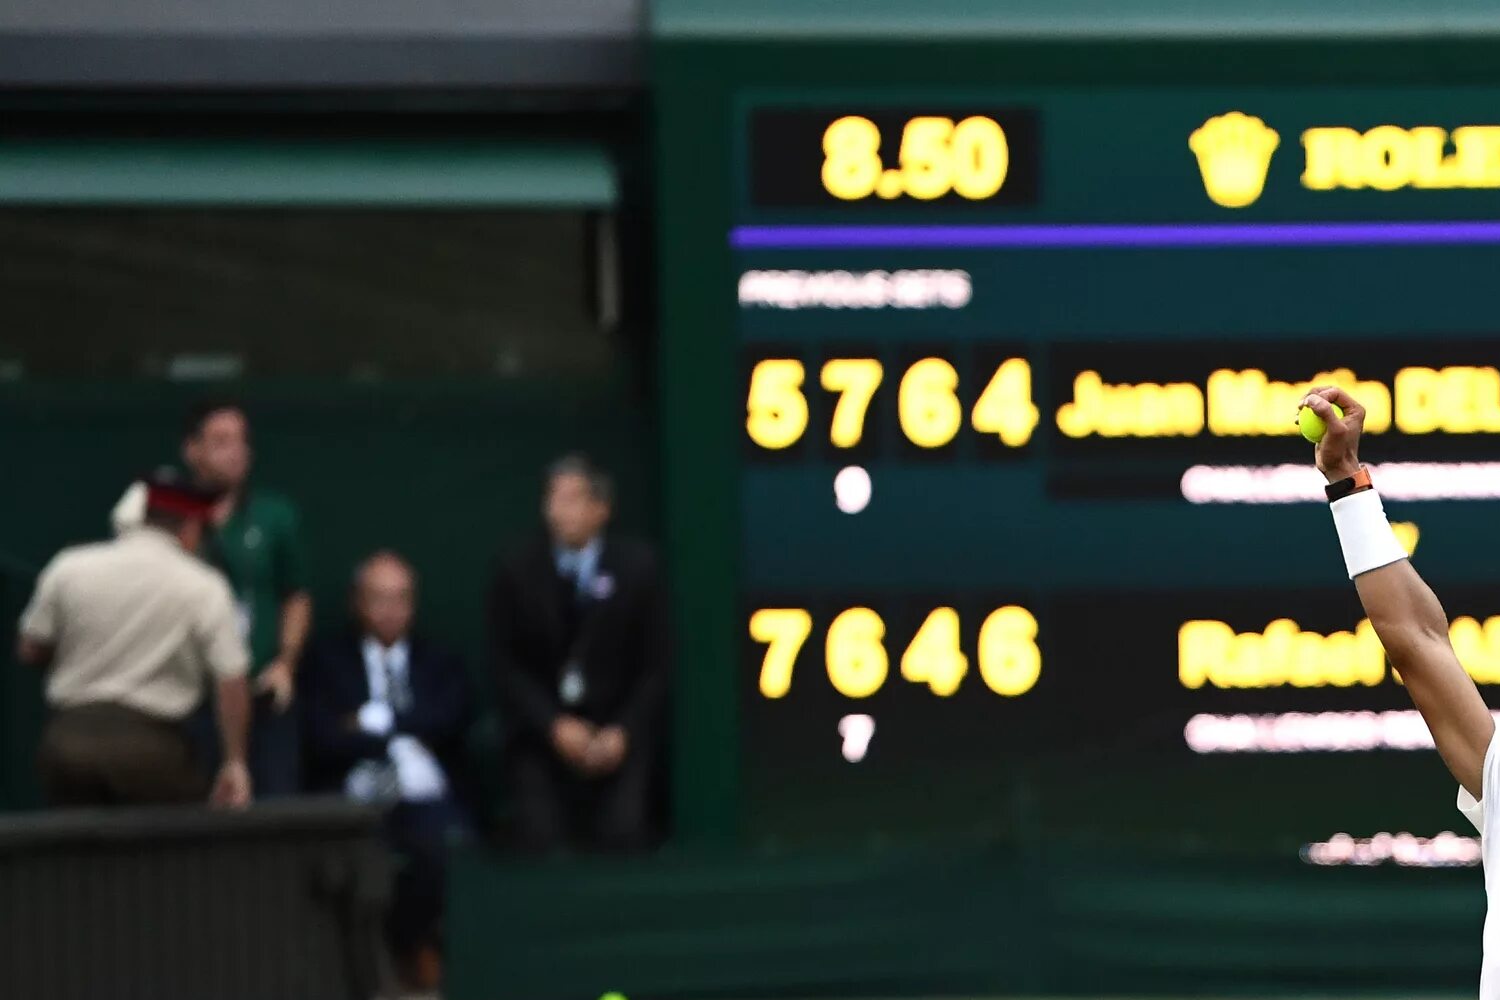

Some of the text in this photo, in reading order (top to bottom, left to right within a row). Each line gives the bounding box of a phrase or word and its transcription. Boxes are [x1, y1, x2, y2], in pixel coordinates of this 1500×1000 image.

[821, 115, 1009, 200] 8.50
[746, 357, 1040, 449] 5 7 6 4
[1055, 370, 1205, 438] Juan
[749, 605, 1042, 699] 7 6 4 6
